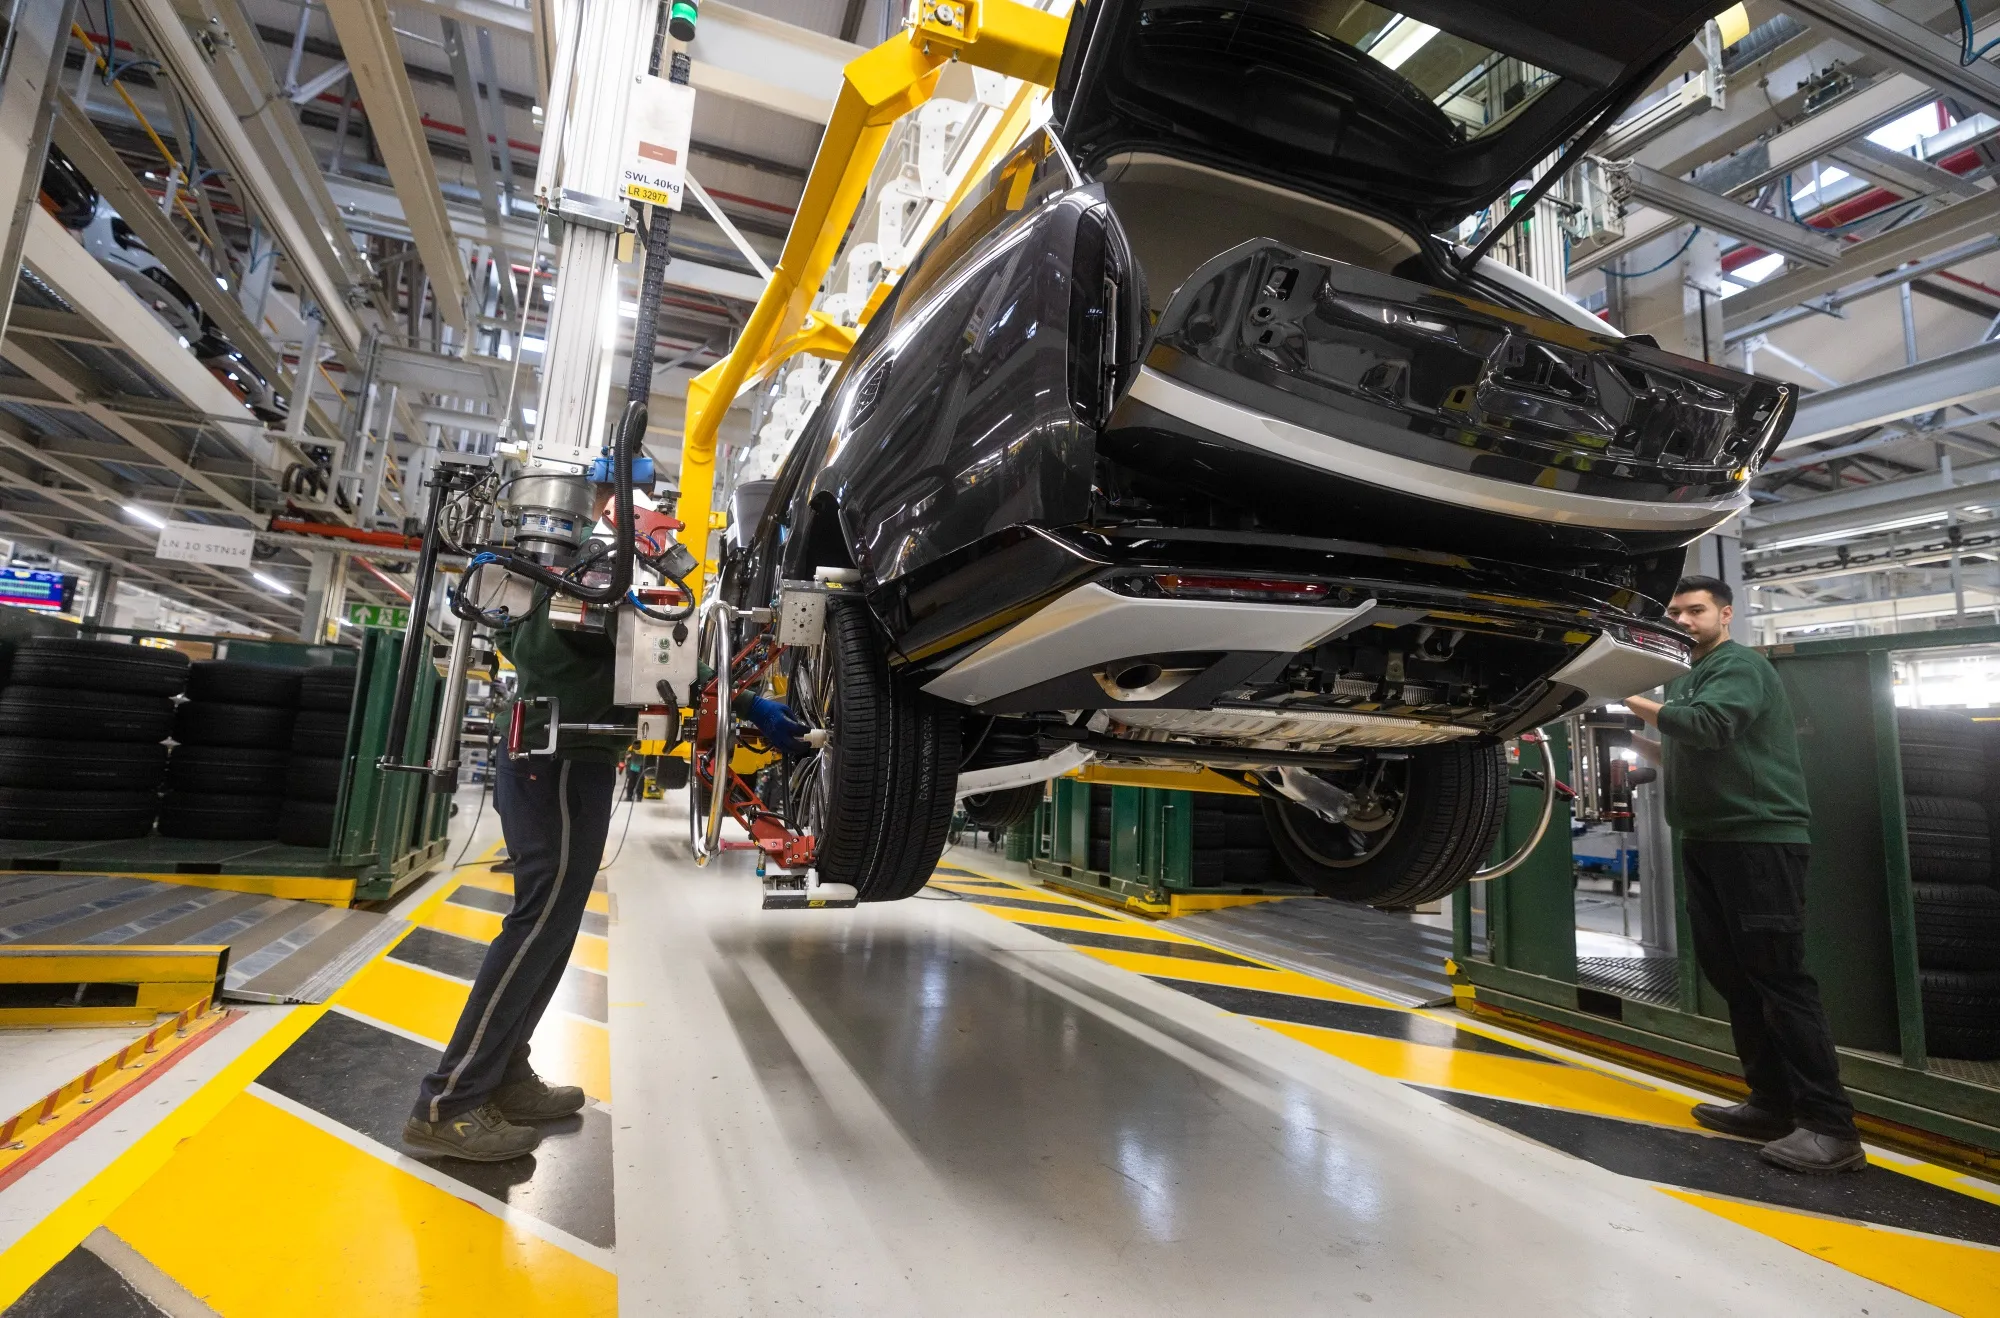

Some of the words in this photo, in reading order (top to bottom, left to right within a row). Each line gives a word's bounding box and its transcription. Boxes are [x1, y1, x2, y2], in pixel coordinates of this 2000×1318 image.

[624, 170, 650, 184] SWL
[653, 178, 680, 193] 40kg
[628, 185, 640, 197] LR
[642, 189, 667, 202] 32977
[162, 539, 179, 548] LN
[184, 541, 200, 551] 10
[205, 543, 247, 556] STN14
